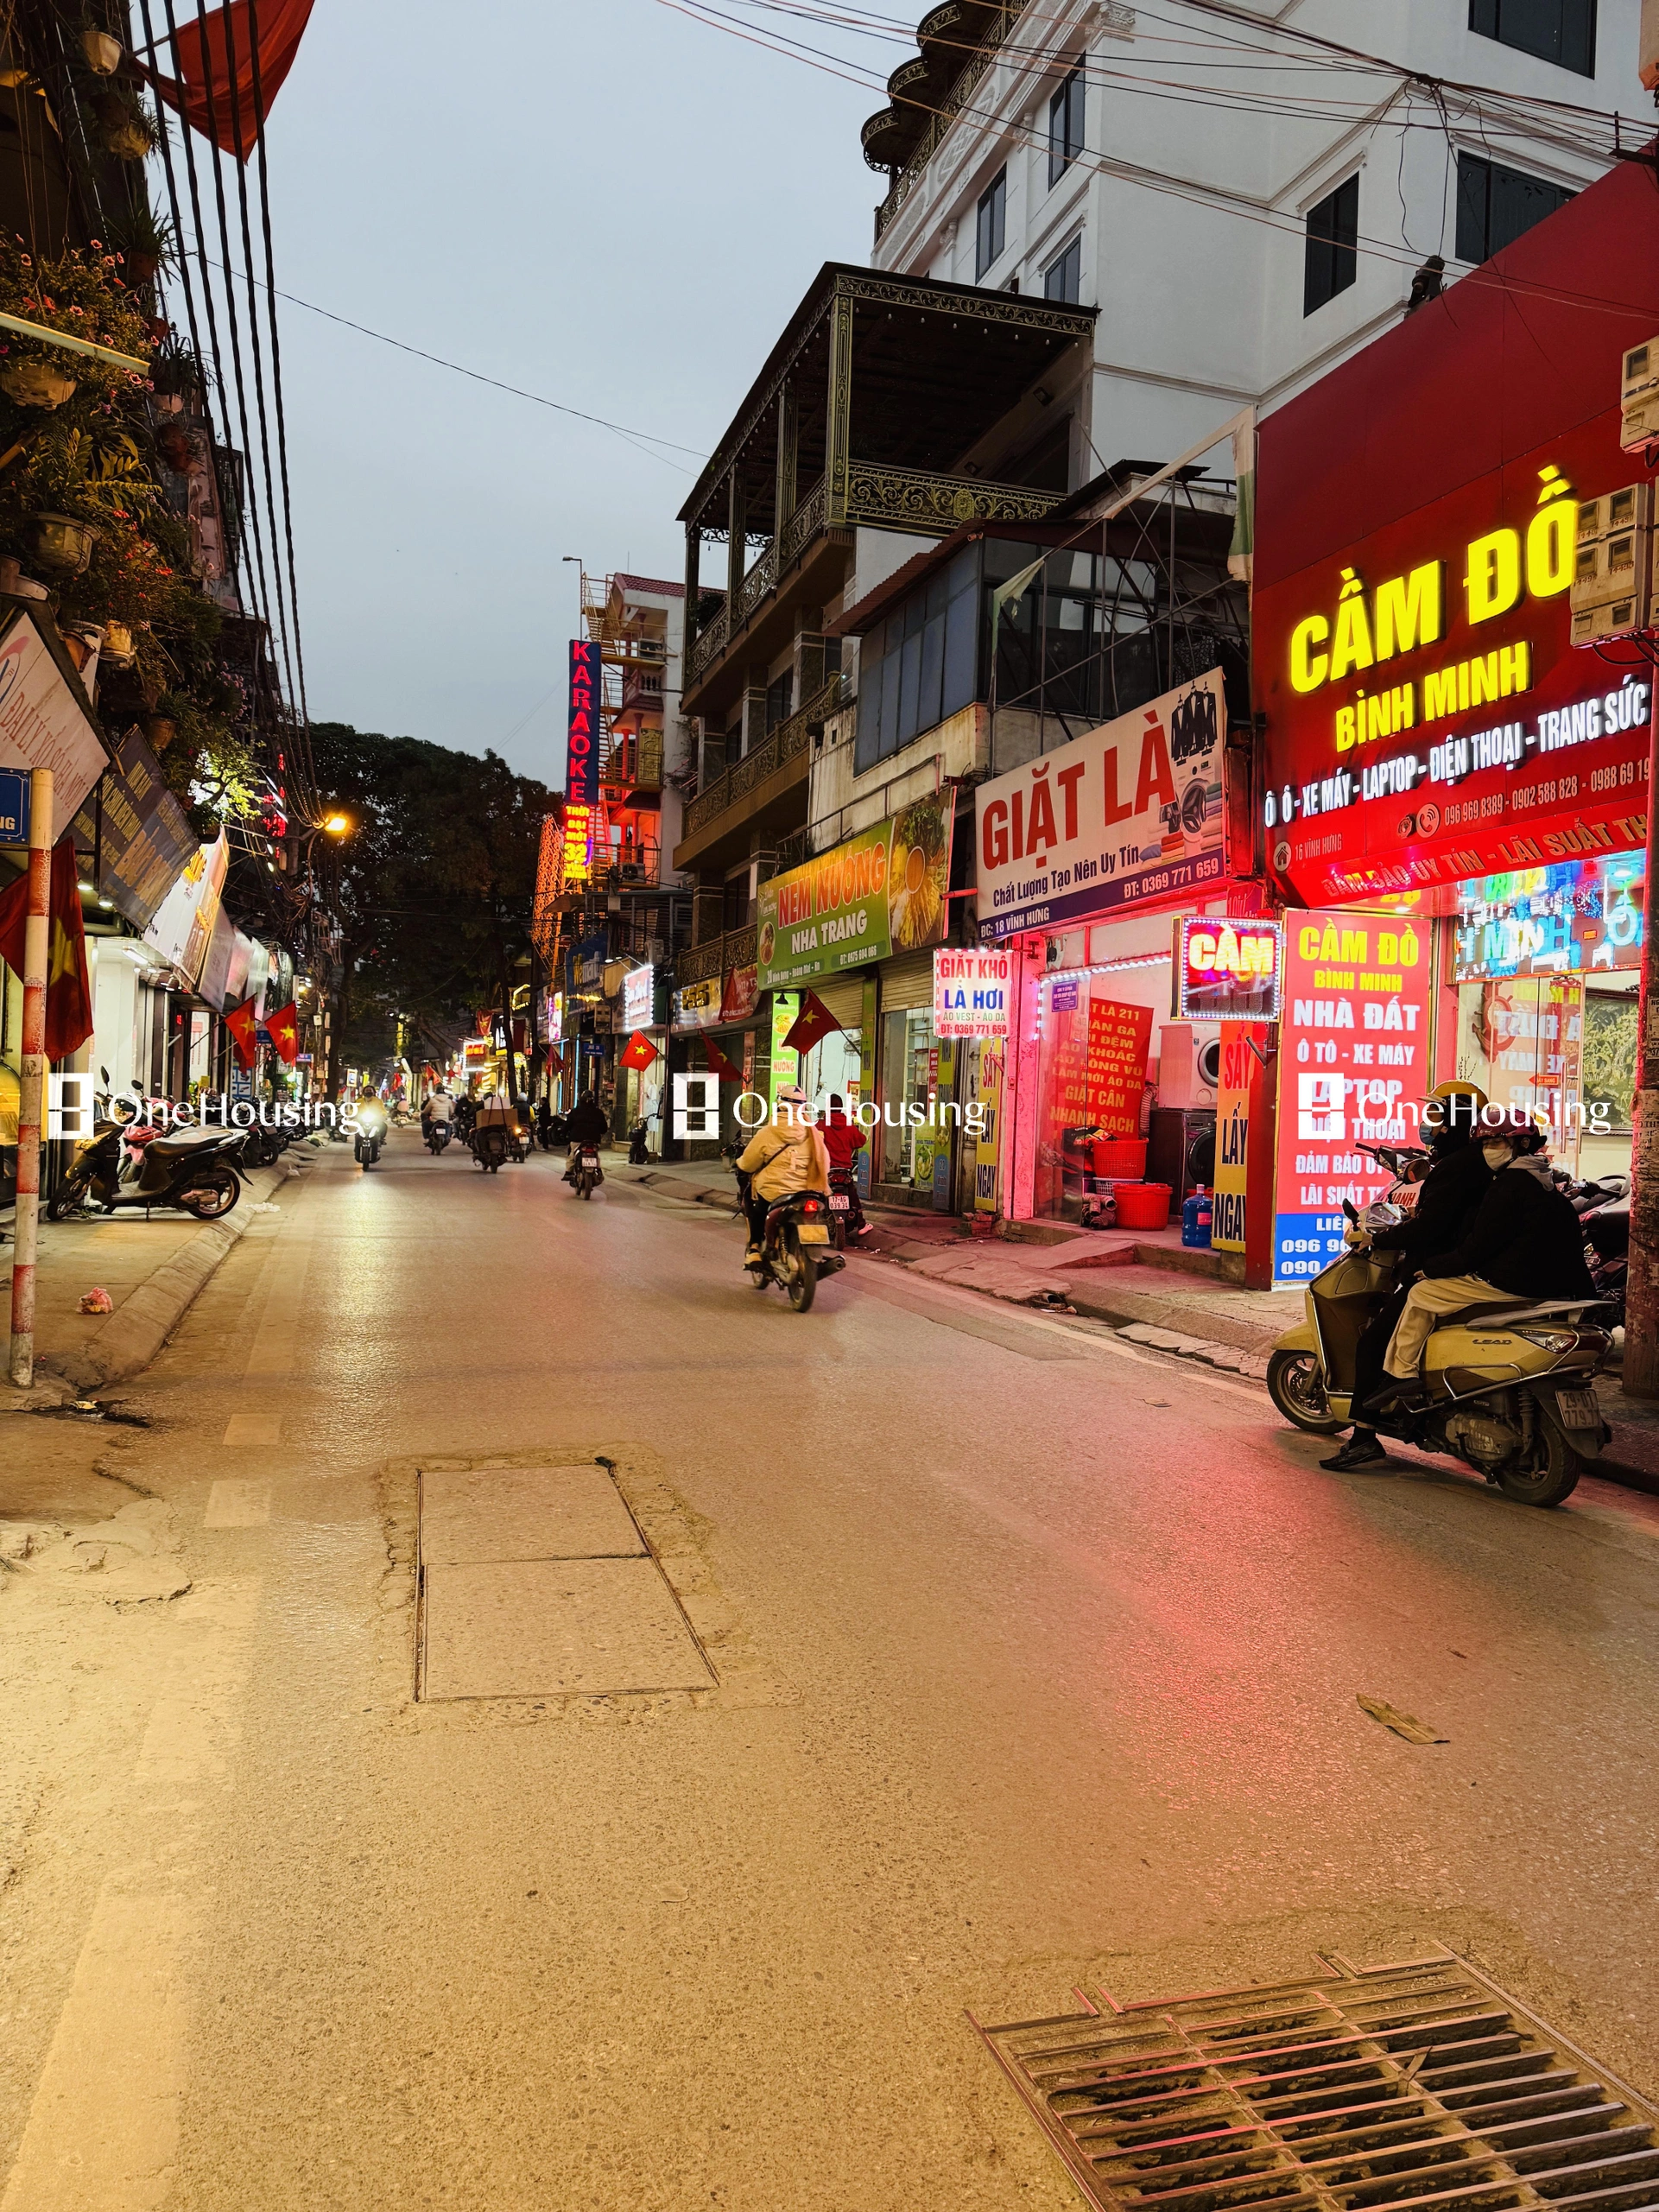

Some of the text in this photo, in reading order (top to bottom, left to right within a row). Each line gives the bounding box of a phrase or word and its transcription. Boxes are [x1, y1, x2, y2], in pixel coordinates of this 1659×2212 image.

[1289, 465, 1580, 693] CẦM ĐỒ
[1336, 642, 1529, 752] BÌNH MINH
[1, 691, 37, 741] ĐẠI
[569, 641, 592, 802] KARAOKE
[1302, 783, 1319, 818] XE
[1321, 767, 1351, 813] MÁY
[1363, 755, 1415, 801] LAPTOP
[1430, 734, 1467, 786] ĐIỆN
[1471, 722, 1523, 770] THOẠI
[1537, 698, 1599, 753] TRANG
[1605, 674, 1646, 735] SỨC
[982, 709, 1176, 871] GIẶT LÀ
[1444, 805, 1461, 826] 096
[1463, 800, 1479, 821] 969
[1481, 794, 1503, 817] 8389
[1512, 786, 1536, 810] 0902
[1537, 781, 1556, 805] 588
[1559, 776, 1578, 799] 828
[1591, 768, 1617, 792] 0988
[1619, 762, 1634, 786] 69
[1295, 844, 1302, 860] 16
[1321, 833, 1342, 855] HƯNG
[1411, 857, 1441, 882] UY
[1441, 847, 1485, 878] TÍN
[1498, 834, 1543, 865] LÃI
[1542, 816, 1613, 857] SUẤT
[778, 875, 813, 930] NEM
[815, 841, 887, 916] NƯỚNG
[993, 843, 1140, 908] Chất Lượng Tạo Nên Uy Tín
[1124, 857, 1219, 899] ĐT: 0369 771 659
[792, 910, 868, 955] NHA TRANG
[995, 920, 1004, 934] 18
[1006, 914, 1024, 930] VĨNH
[1027, 907, 1050, 925] HƯNG
[1299, 917, 1368, 965] CẦM
[1377, 922, 1419, 967] ĐỒ
[940, 954, 1008, 983] GIẶT KHÔ
[1314, 967, 1403, 992] BÌNH MINH
[944, 985, 1004, 1010] LÀ HƠI
[956, 1012, 975, 1021] VEST
[995, 1012, 1005, 1022] DA
[1101, 1004, 1116, 1017] LÀ
[1119, 1008, 1140, 1021] 211
[1293, 995, 1421, 1031] NHÀ ĐẤT
[940, 1024, 1006, 1035] ĐT: 0369 771 659
[1101, 1035, 1134, 1049] ĐỆM
[1118, 1026, 1137, 1036] GA
[1081, 1058, 1119, 1073] ÔNG
[1087, 1045, 1136, 1062] KHOÁC
[1225, 1021, 1251, 1091] SẤY
[1297, 1037, 1309, 1062] Ô
[1314, 1039, 1337, 1063] TÔ
[1352, 1043, 1373, 1064] XE
[1378, 1042, 1415, 1066] MÁY
[1065, 1085, 1125, 1108] GIẶT CÂN
[1107, 1075, 1123, 1087] ÁO
[1127, 1081, 1142, 1090] DA
[1049, 1106, 1134, 1134] NHANH SẠCH
[1222, 1101, 1249, 1165] LẤY
[1295, 1150, 1328, 1174] ĐẢM
[1333, 1150, 1362, 1174] BẢO
[977, 1163, 997, 1201] NGAY
[1301, 1182, 1322, 1205] LÃI
[1327, 1180, 1364, 1206] SUẤT
[1282, 1239, 1320, 1253] 096
[1281, 1260, 1320, 1275] 090
